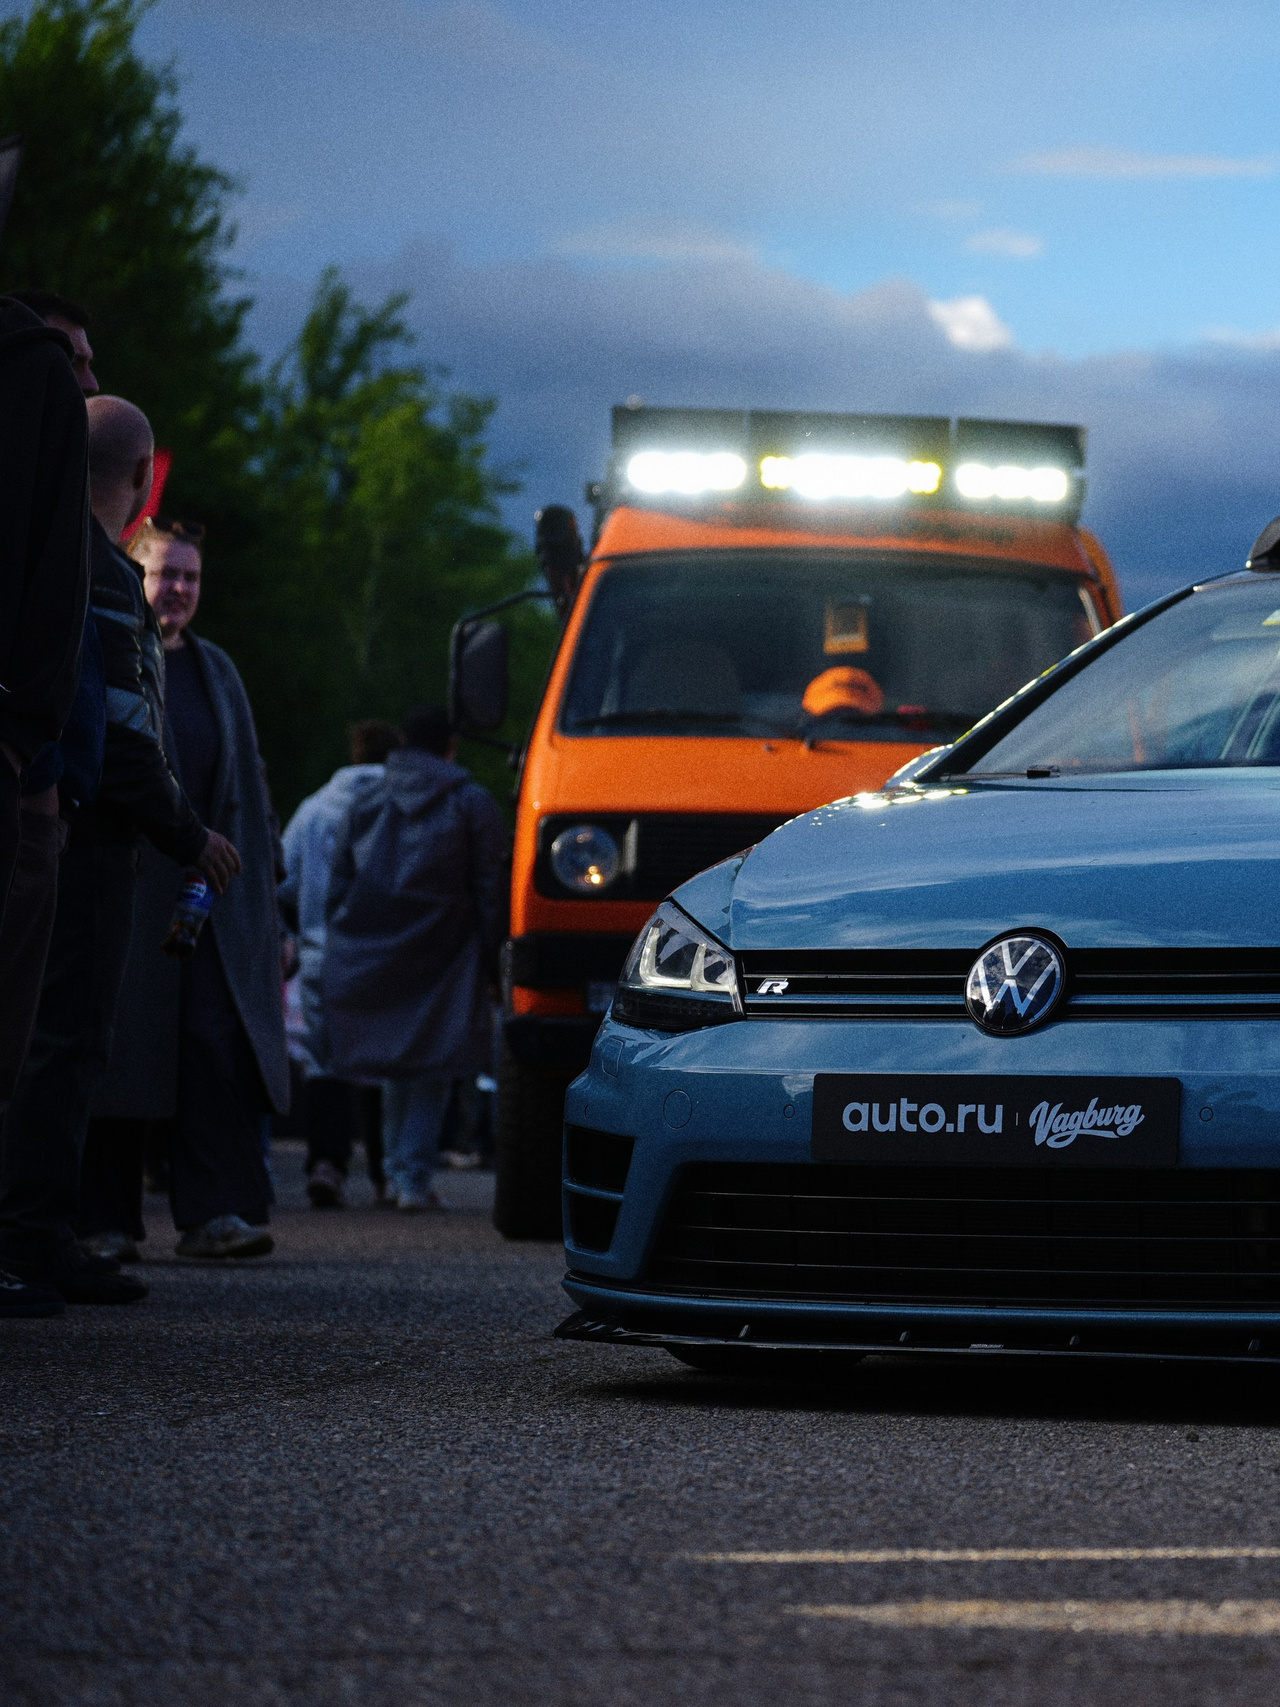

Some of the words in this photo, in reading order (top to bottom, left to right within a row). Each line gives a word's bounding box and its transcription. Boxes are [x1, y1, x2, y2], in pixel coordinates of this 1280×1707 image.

[756, 977, 790, 996] R
[972, 938, 1061, 1025] VW
[842, 1097, 1004, 1134] auto.ru
[1028, 1096, 1145, 1149] Vagburg
